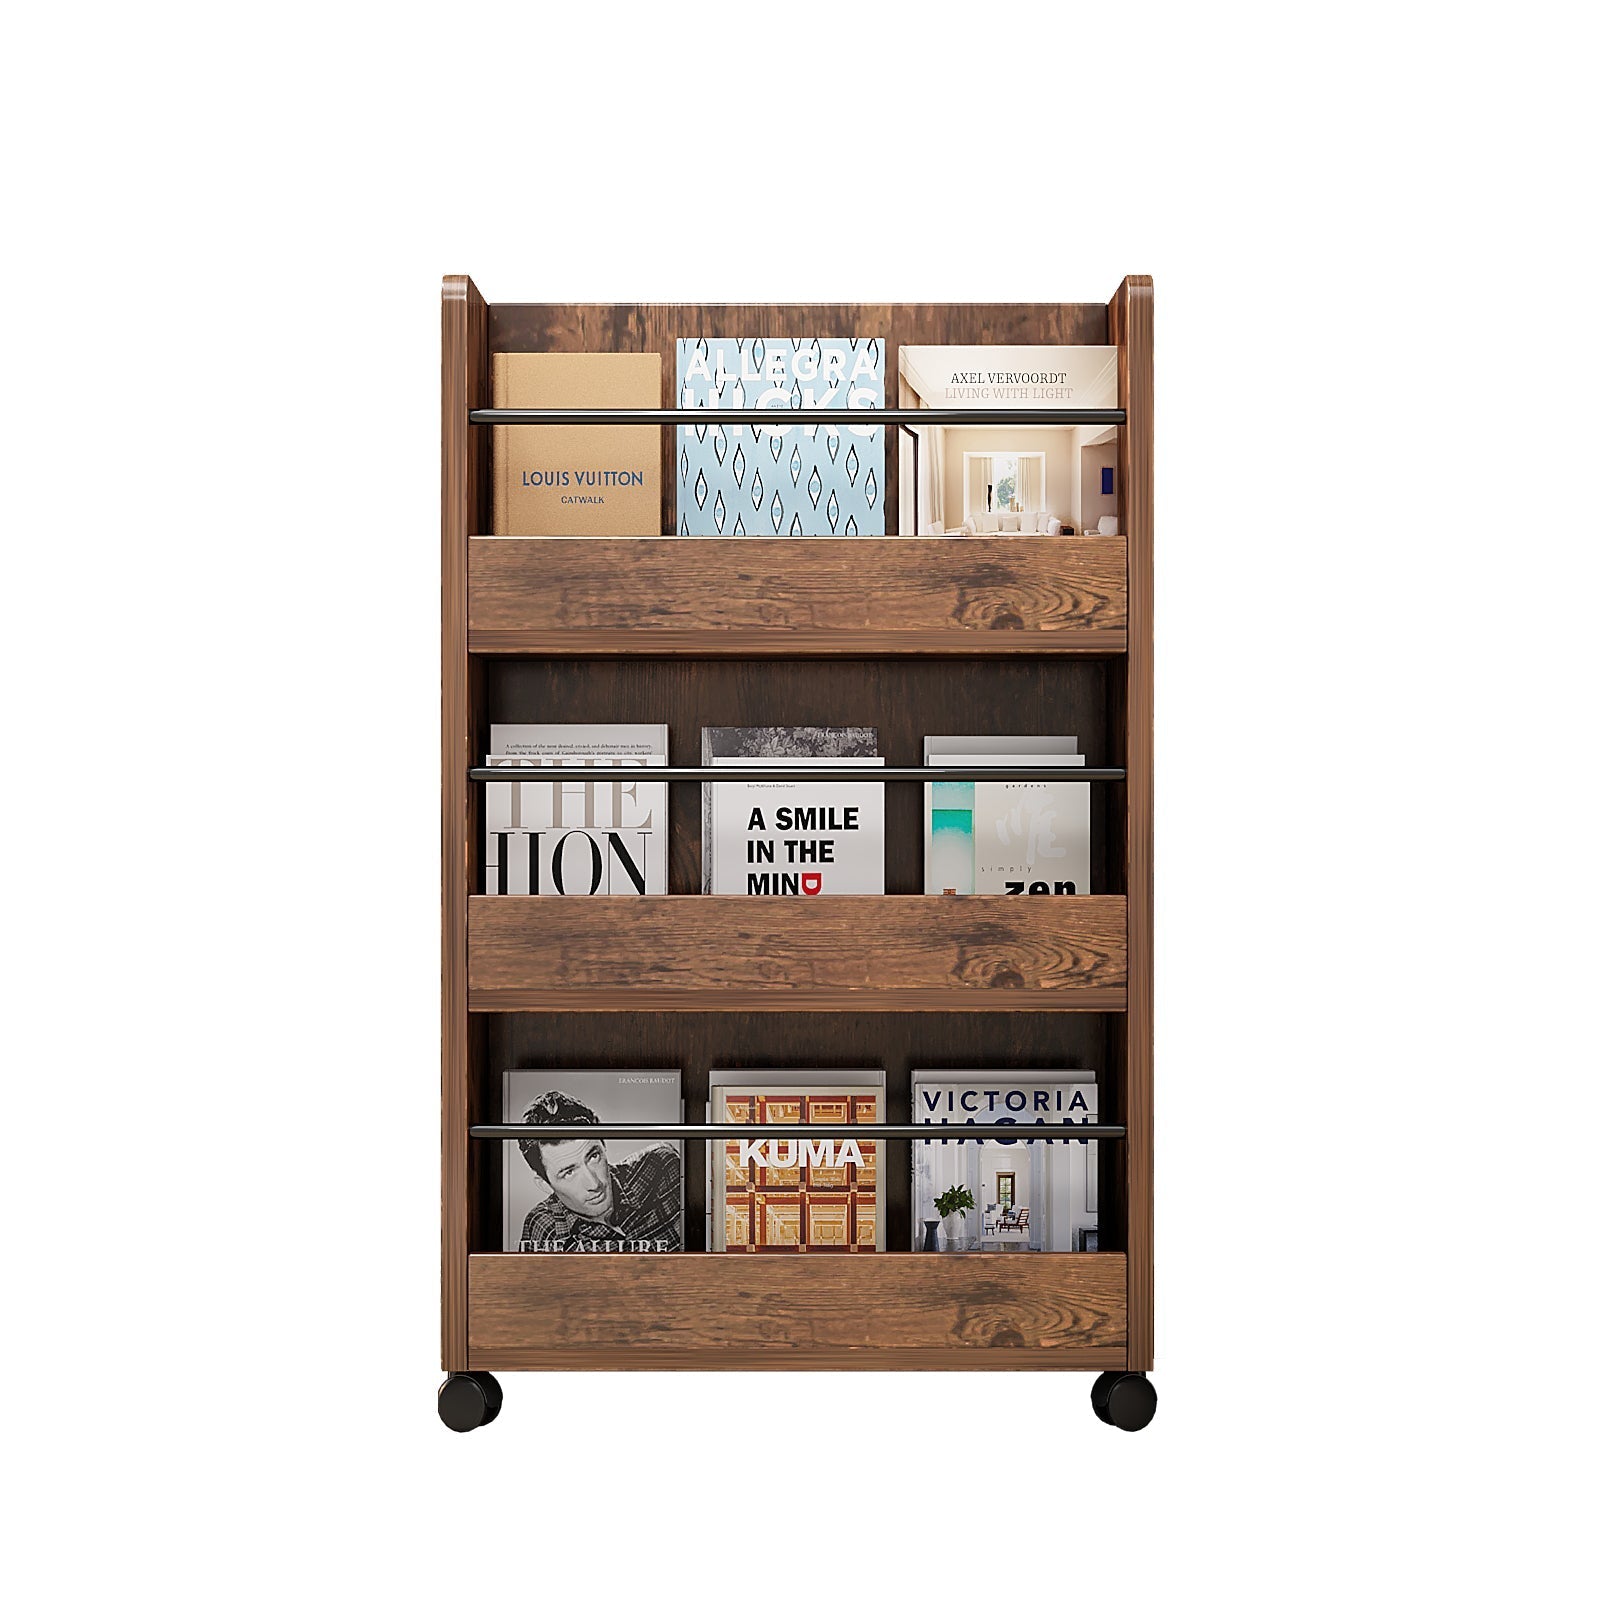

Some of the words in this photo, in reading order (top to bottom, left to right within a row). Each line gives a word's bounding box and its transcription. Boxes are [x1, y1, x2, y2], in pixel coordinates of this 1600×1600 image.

[684, 348, 878, 381] ALLEGRA
[951, 372, 985, 384] AXEL
[988, 372, 1067, 384] VERVOORDT
[945, 387, 990, 399] LIVING
[992, 387, 1029, 399] WITH
[1032, 387, 1073, 399] LIGHT
[684, 388, 880, 437] HICKS
[522, 471, 570, 486] LOUIS
[575, 471, 643, 486] VUITTON
[561, 496, 605, 504] CATWALK
[490, 758, 653, 829] THE
[747, 807, 766, 830] A
[775, 807, 859, 830] SMILE
[747, 840, 774, 863] IN
[784, 840, 835, 863] THE
[981, 865, 1033, 873] simply
[747, 872, 822, 895] MIND
[1004, 881, 1077, 895] zen
[923, 1090, 1089, 1112] VICTORIA
[739, 1138, 866, 1168] KUMA
